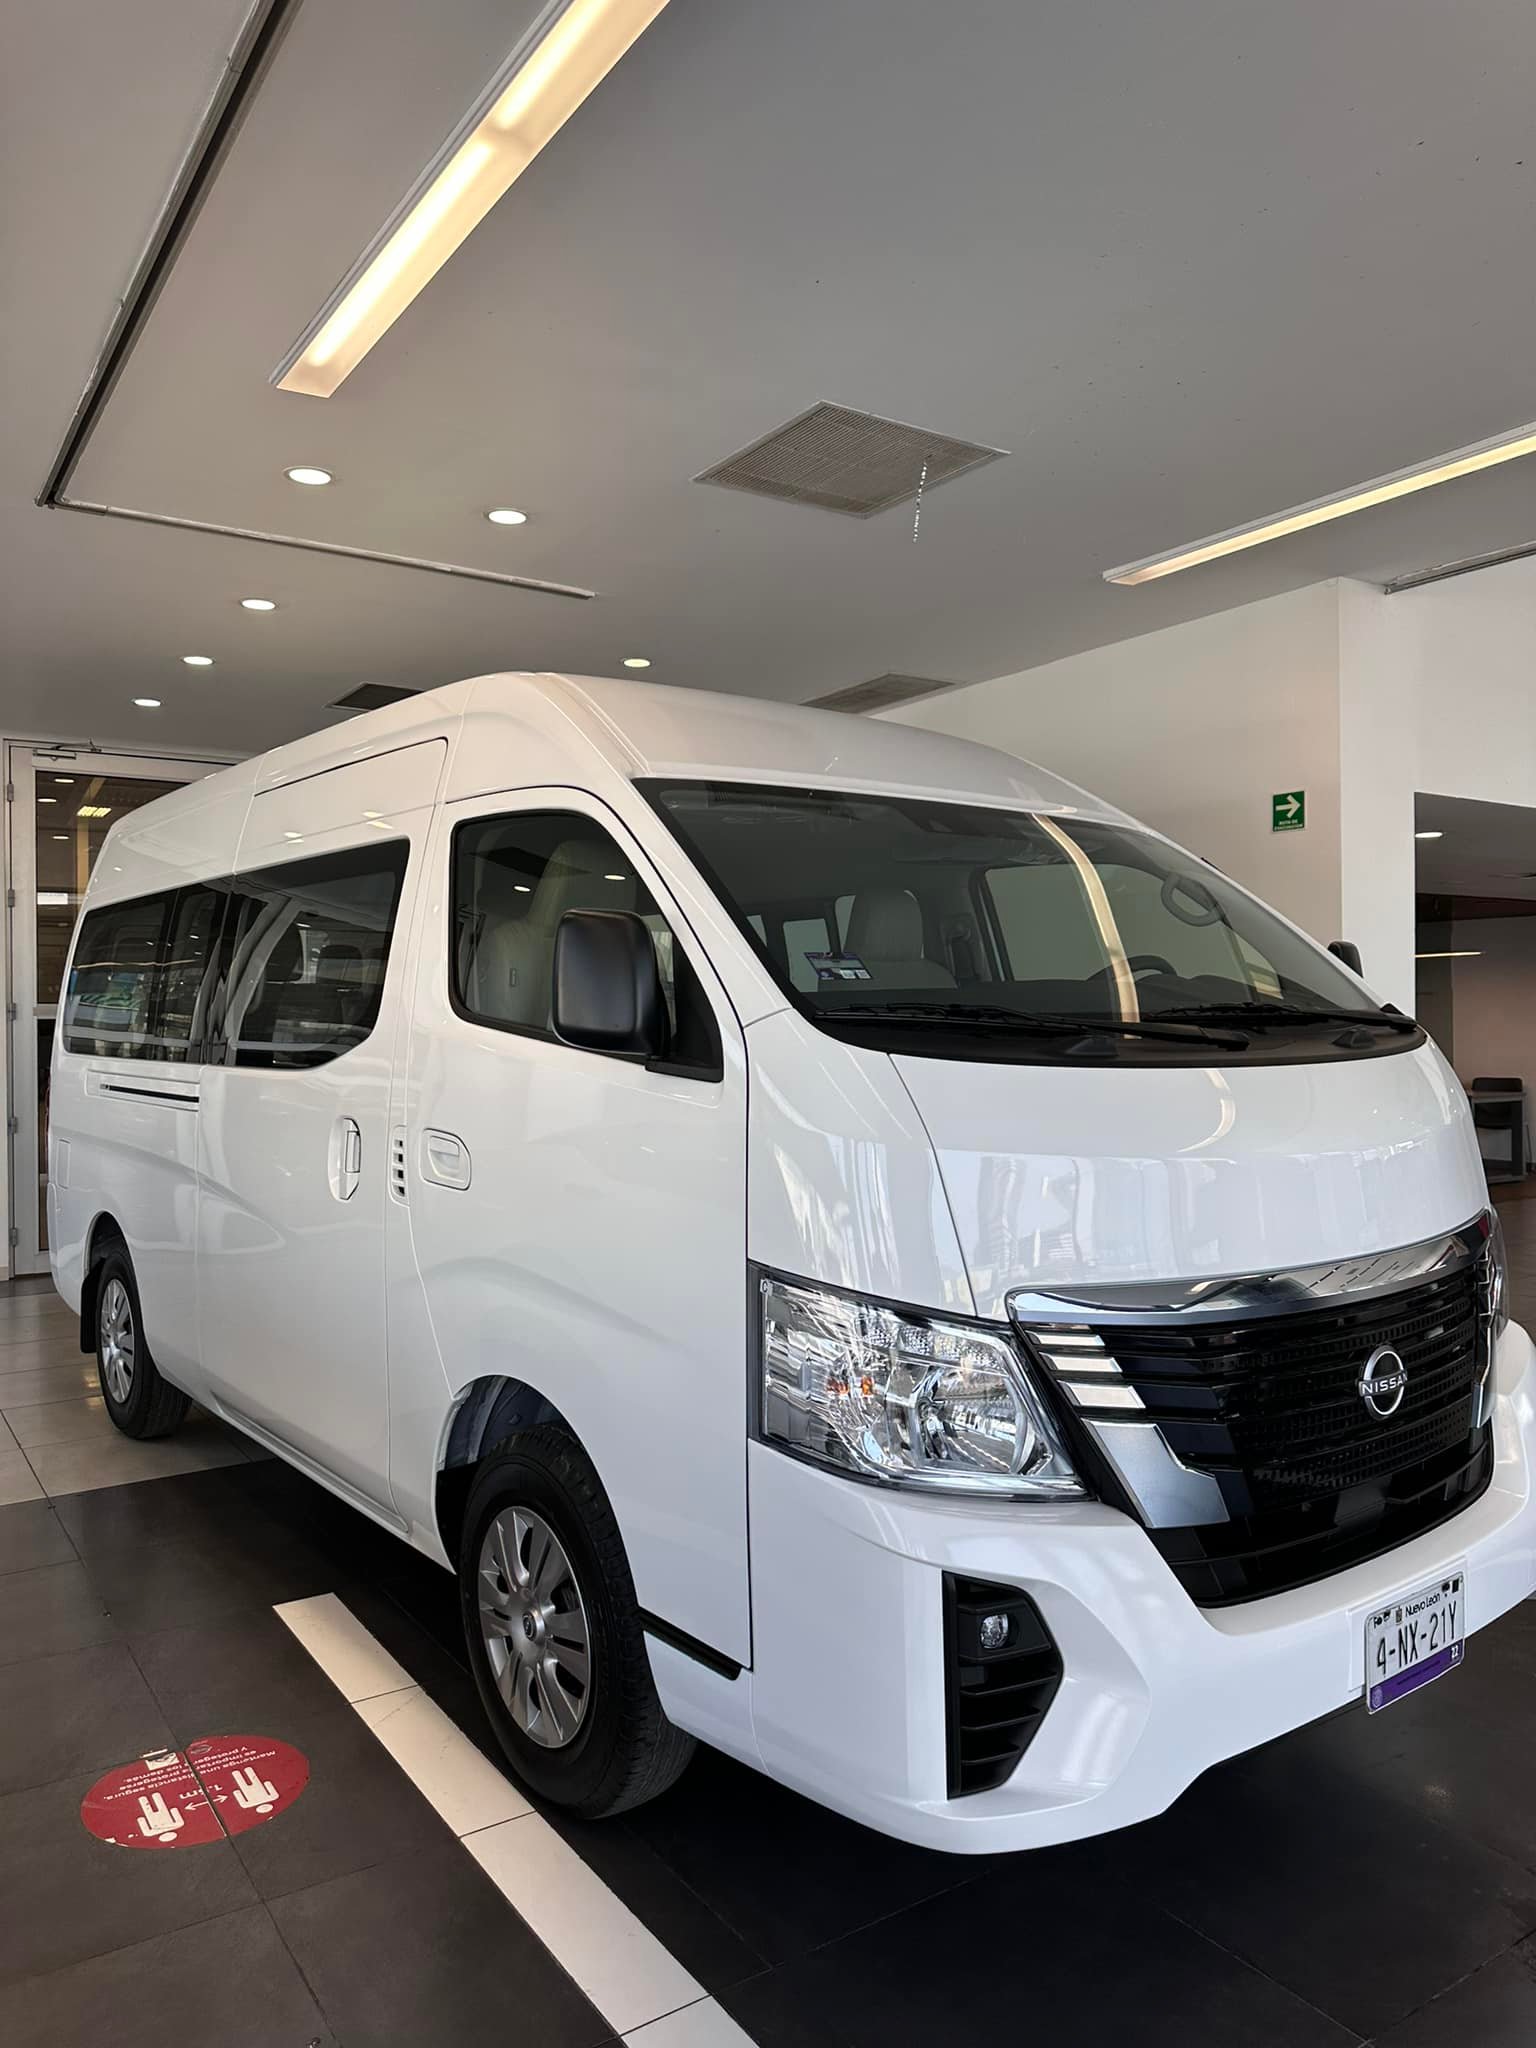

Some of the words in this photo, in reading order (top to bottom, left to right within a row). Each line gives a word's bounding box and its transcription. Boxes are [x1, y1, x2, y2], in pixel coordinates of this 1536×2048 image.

[1362, 1374, 1407, 1394] NISSA
[1405, 1600, 1425, 1617] Nuevo
[1377, 1600, 1457, 1675] 4-NX-21Y
[193, 1748, 239, 1765] proteger
[223, 1750, 276, 1769] Mantenga
[199, 1766, 221, 1775] una
[119, 1770, 180, 1791] protegerse
